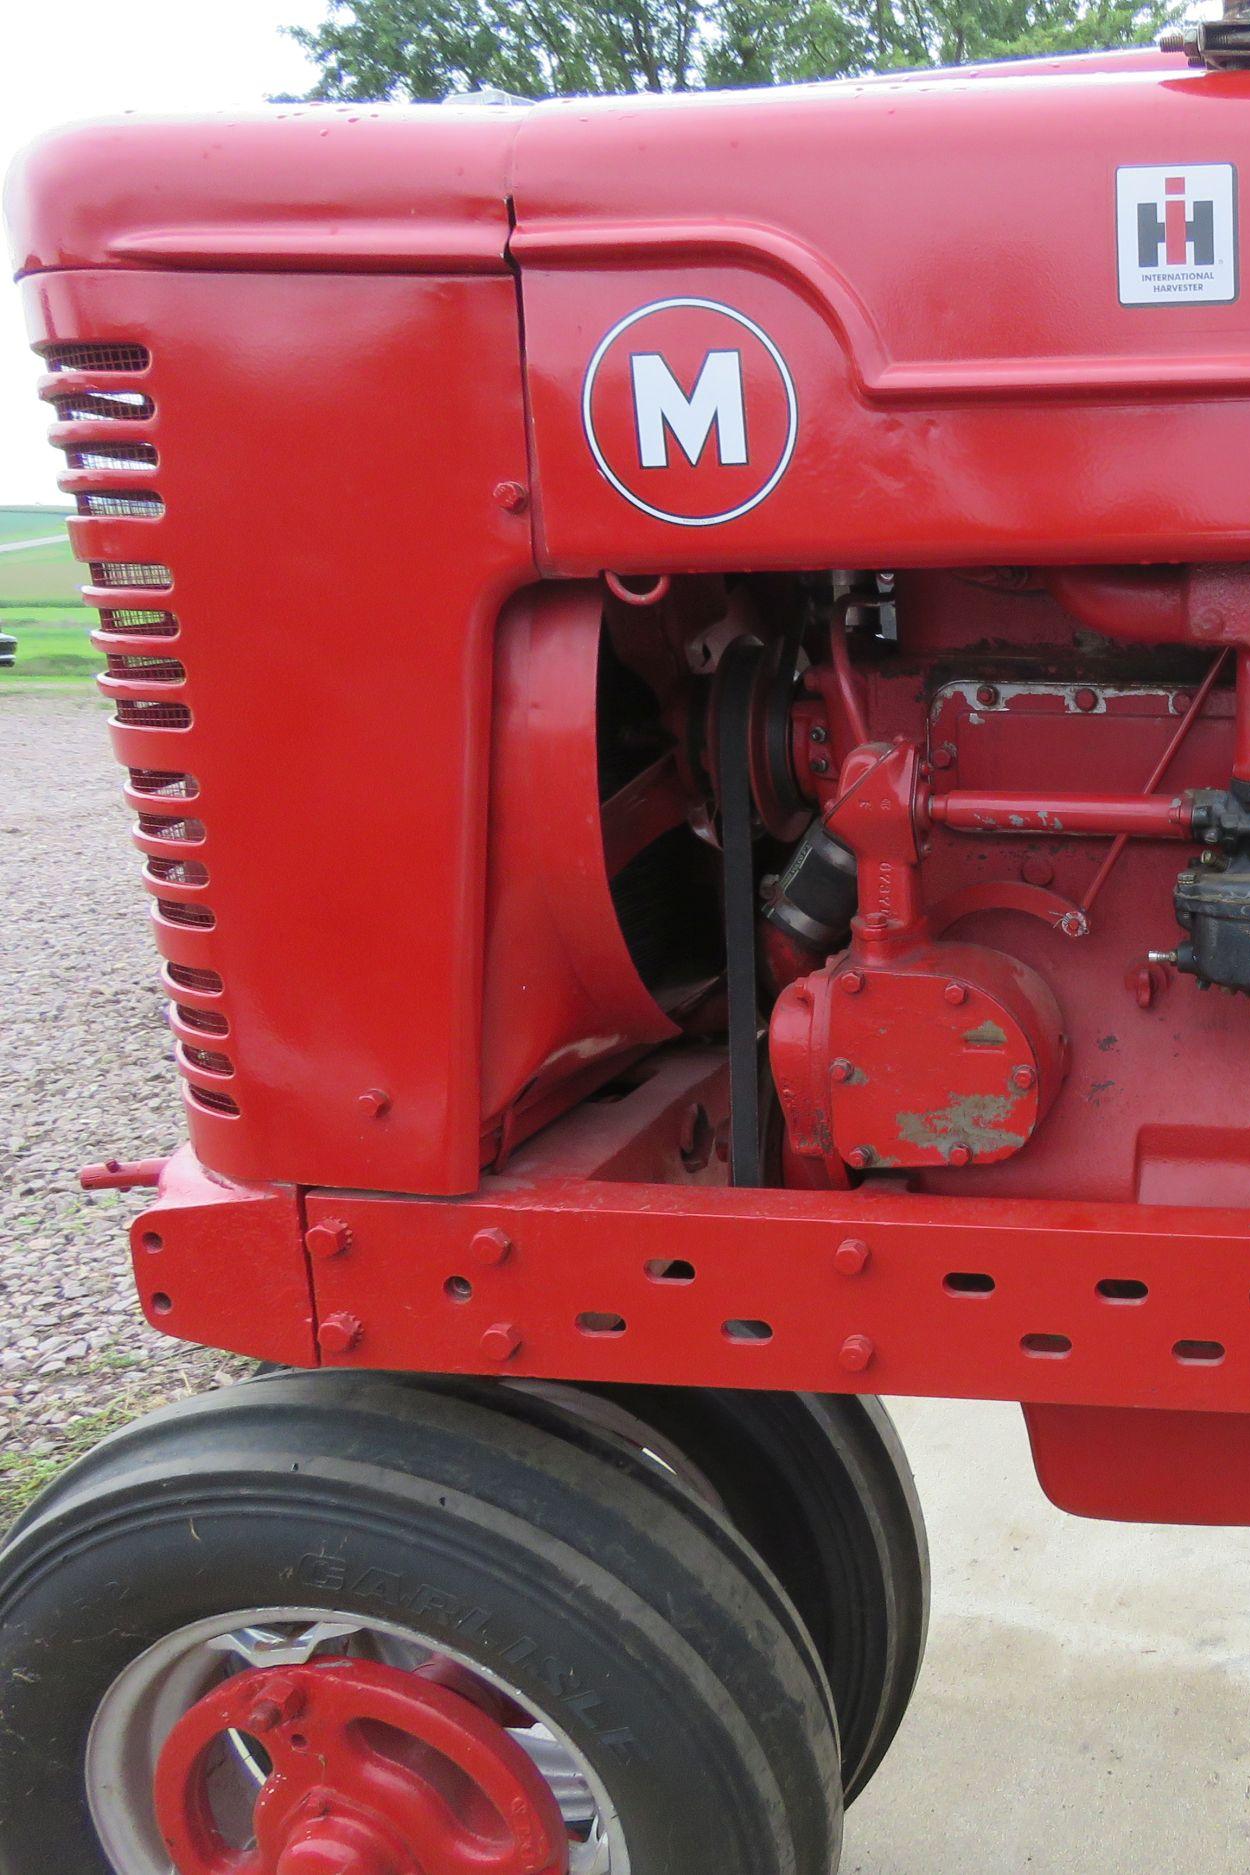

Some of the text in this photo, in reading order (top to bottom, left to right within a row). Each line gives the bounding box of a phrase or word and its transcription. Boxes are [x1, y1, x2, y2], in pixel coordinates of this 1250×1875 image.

[1141, 272, 1215, 282] INTERNATIONAL
[1153, 283, 1204, 293] HARVESTER
[630, 349, 750, 469] M
